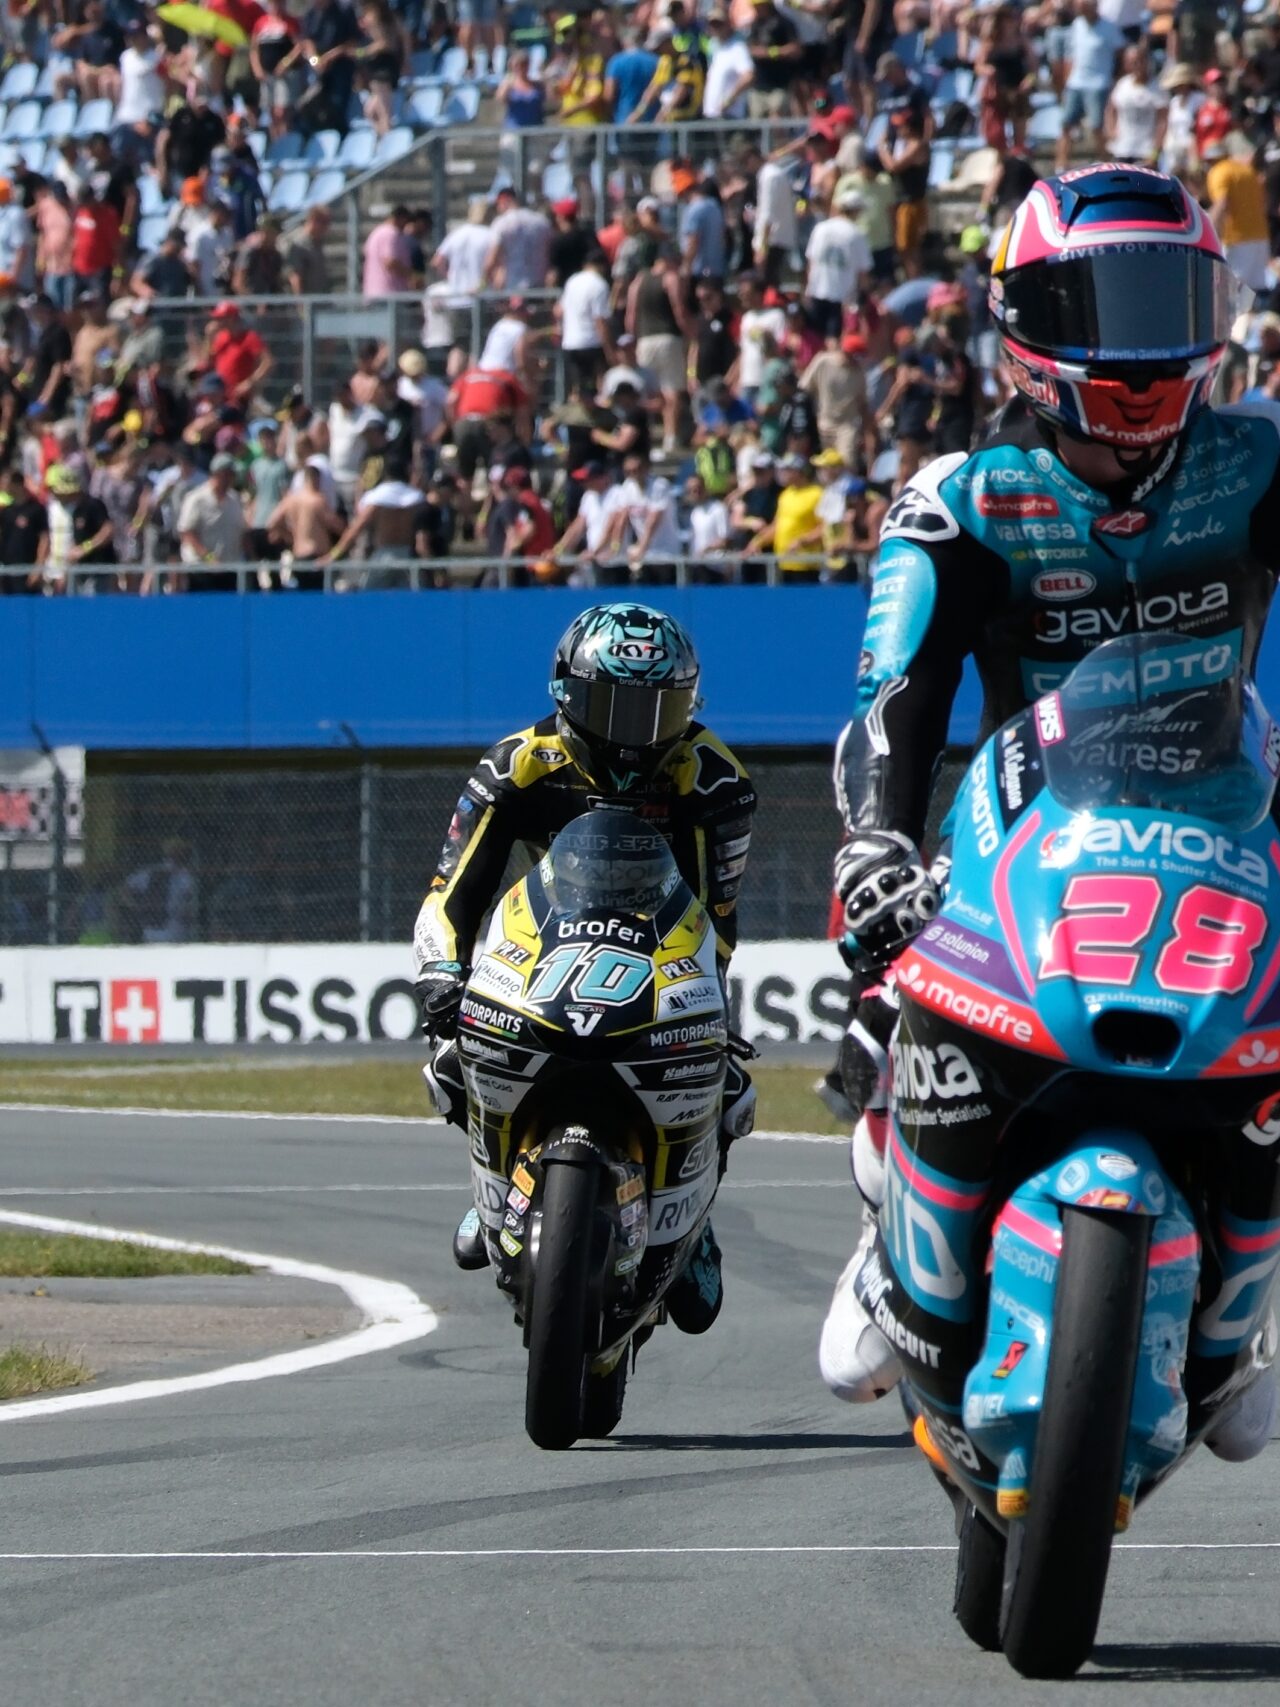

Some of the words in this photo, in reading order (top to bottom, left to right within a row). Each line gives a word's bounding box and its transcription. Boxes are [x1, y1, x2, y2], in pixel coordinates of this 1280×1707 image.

[1114, 243, 1150, 253] YOU
[1117, 424, 1178, 443] mapfre
[1168, 477, 1251, 515] ASCALE
[1029, 548, 1088, 561] MOTOREX
[1040, 577, 1087, 593] BELL
[1035, 582, 1229, 643] gaviota
[613, 644, 666, 660] KYT
[618, 678, 653, 688] brofer.it
[1031, 645, 1232, 694] CFMOTO
[1040, 696, 1061, 741] WRS
[535, 750, 563, 764] KYT
[1066, 741, 1203, 774] valresa
[970, 752, 1000, 858] CFMOTO
[1039, 810, 1270, 889] gaviota
[1096, 855, 1118, 867] The
[1121, 857, 1146, 869] Sun
[1148, 859, 1158, 870] &
[1161, 859, 1207, 877] Shutter
[558, 918, 645, 945] brofer
[1037, 874, 1269, 995] 28
[940, 931, 991, 966] solunion
[480, 962, 521, 993] PALLADIO
[526, 942, 656, 1007] 10
[460, 998, 523, 1034] MOTORPARTS
[563, 1005, 606, 1014] RONCATO
[925, 980, 1034, 1042] mapfre
[1083, 991, 1189, 1014] azulmarino
[936, 1103, 992, 1128] Specialists
[873, 1297, 942, 1371] CIRCUIT
